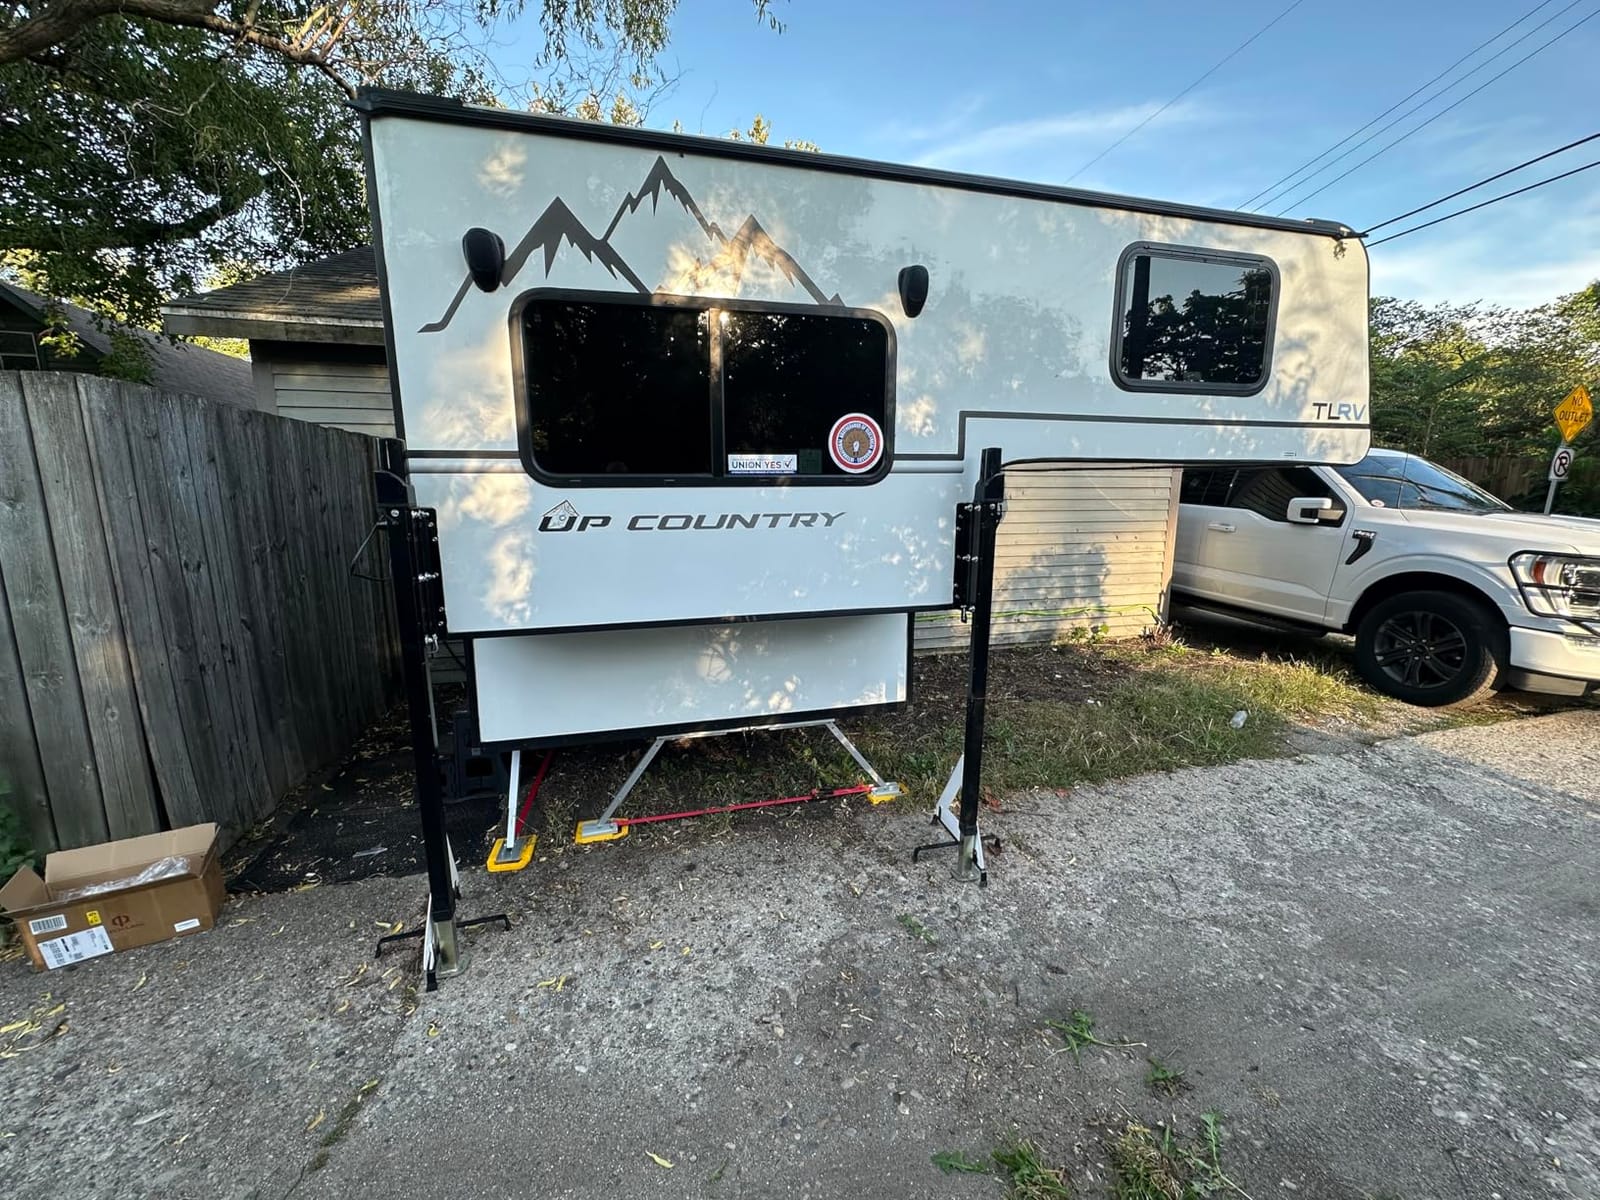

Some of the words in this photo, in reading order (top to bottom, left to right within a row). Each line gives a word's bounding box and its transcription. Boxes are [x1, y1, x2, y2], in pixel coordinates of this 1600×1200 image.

[1572, 396, 1584, 407] NO
[1312, 402, 1366, 420] TLRV
[1559, 410, 1590, 423] OUTLET
[731, 461, 762, 469] UNION
[764, 461, 782, 469] YES
[537, 513, 612, 532] UP
[626, 511, 847, 531] COUNTRY
